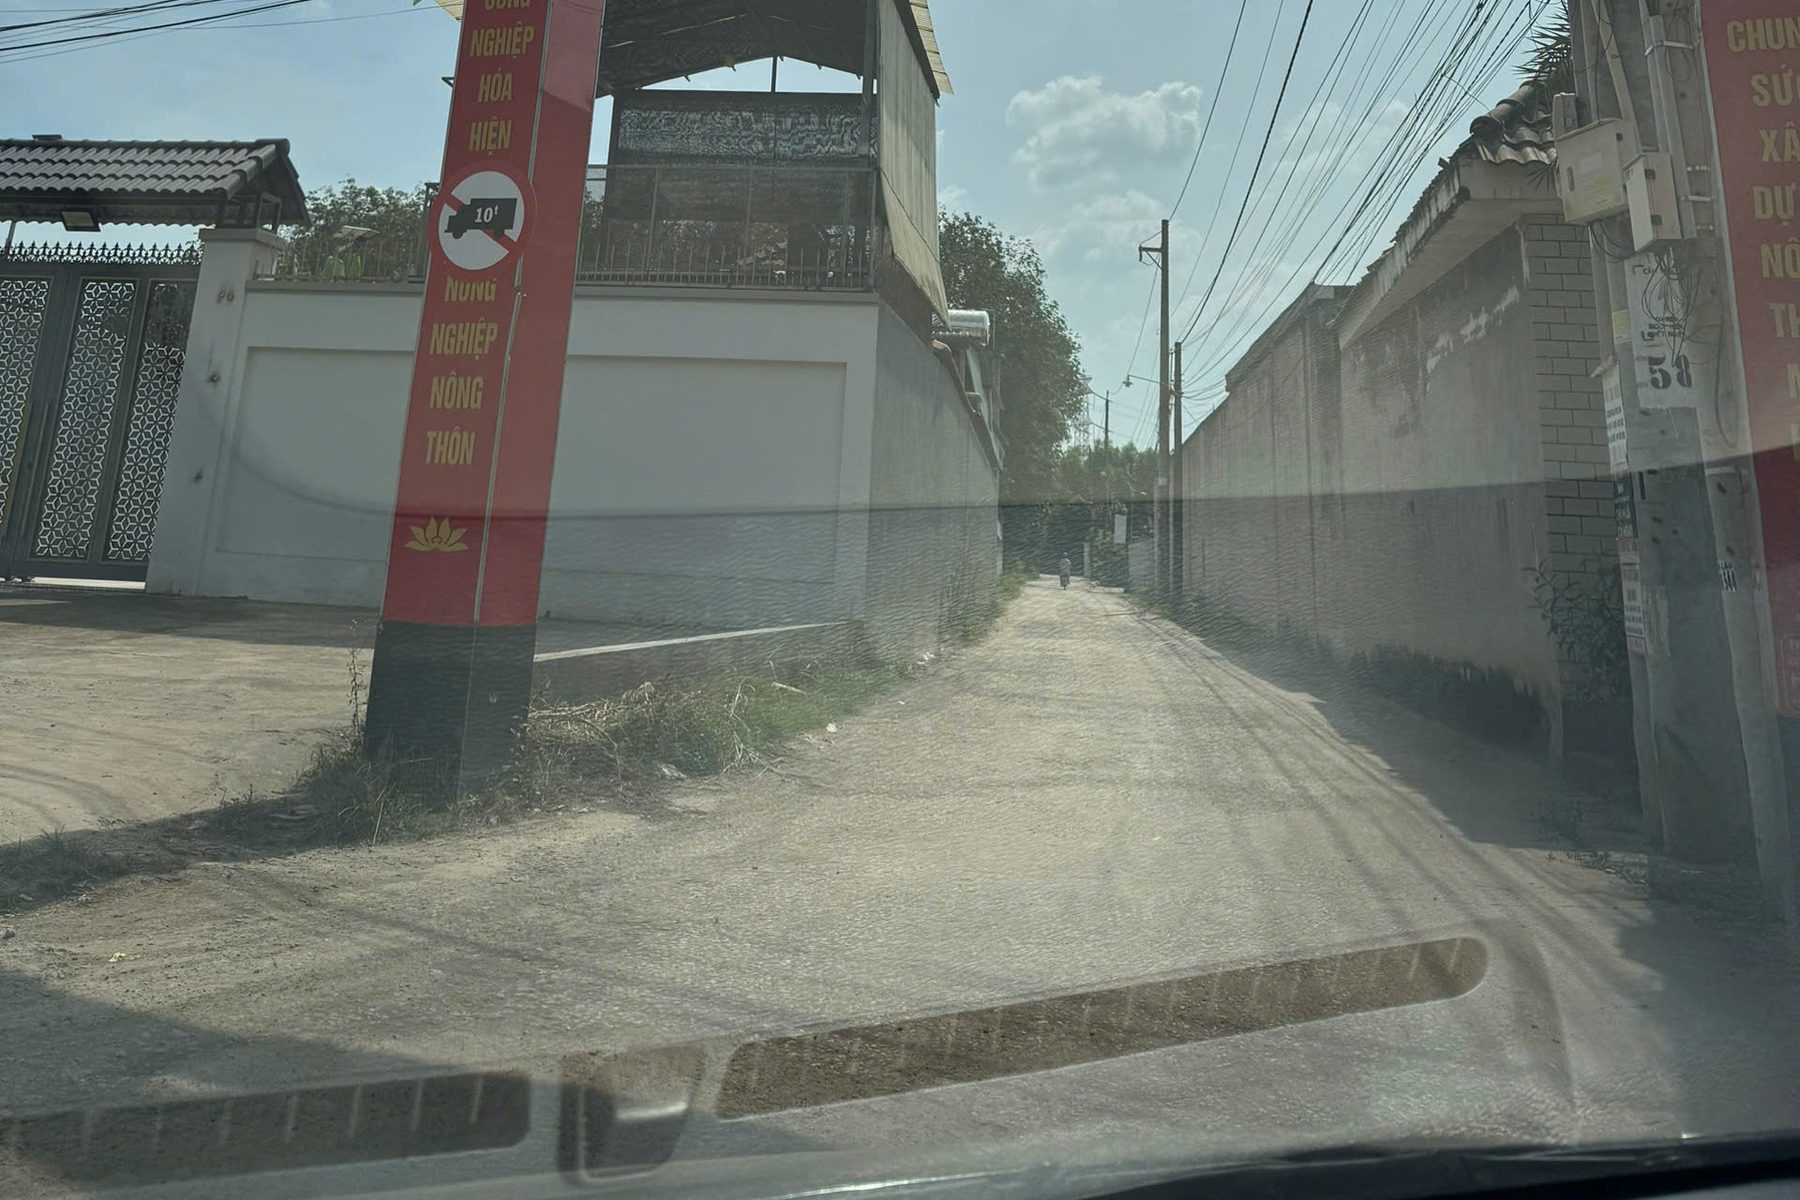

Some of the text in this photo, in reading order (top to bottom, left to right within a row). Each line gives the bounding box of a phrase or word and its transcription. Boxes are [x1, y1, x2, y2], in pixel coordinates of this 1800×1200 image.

[470, 20, 536, 60] NGHIỆP
[478, 67, 514, 103] HÓA
[468, 118, 512, 155] HIỆN
[429, 317, 499, 360] NGHIỆP
[429, 371, 484, 410] NÔNG
[425, 426, 476, 465] THÔN
